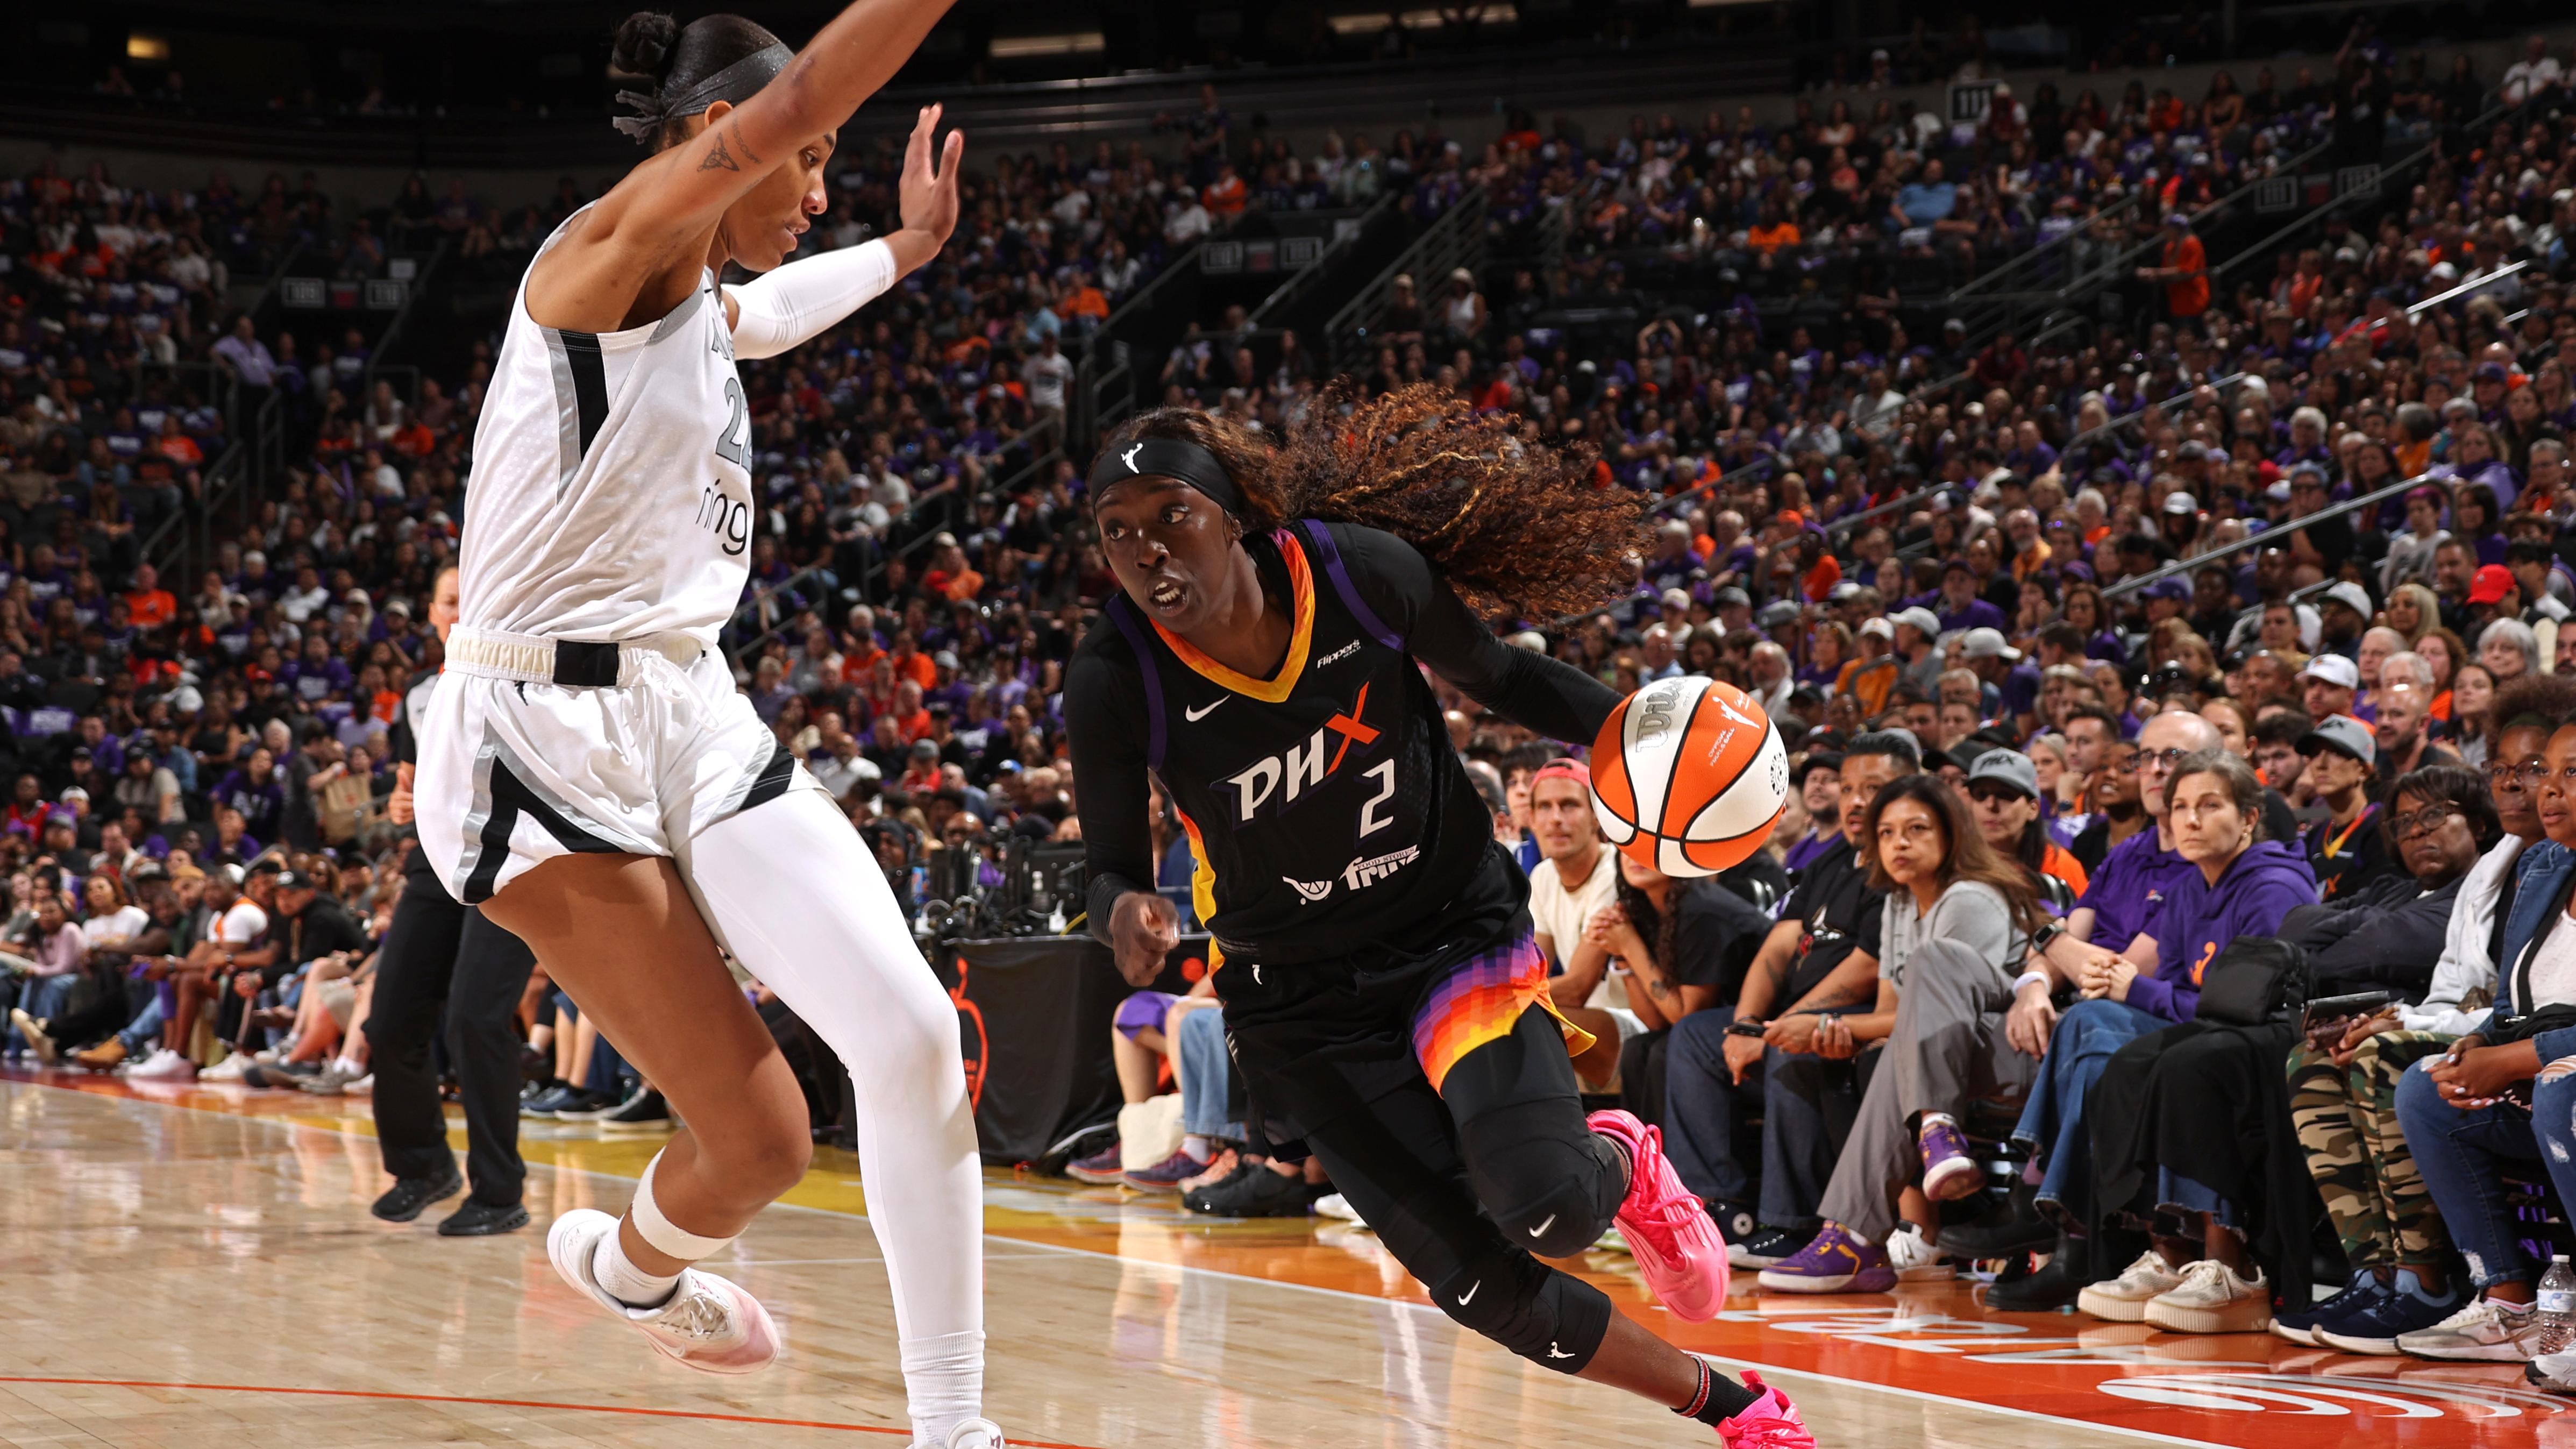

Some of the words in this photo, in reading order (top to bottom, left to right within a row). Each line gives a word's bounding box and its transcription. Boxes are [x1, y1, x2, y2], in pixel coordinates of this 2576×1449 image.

[696, 478, 748, 556] ring
[1226, 681, 1381, 821] PHX
[1723, 727, 1735, 744] BALL
[1359, 758, 1395, 839] 2
[1357, 858, 1380, 870] FOOD
[1383, 847, 1415, 862] STORES
